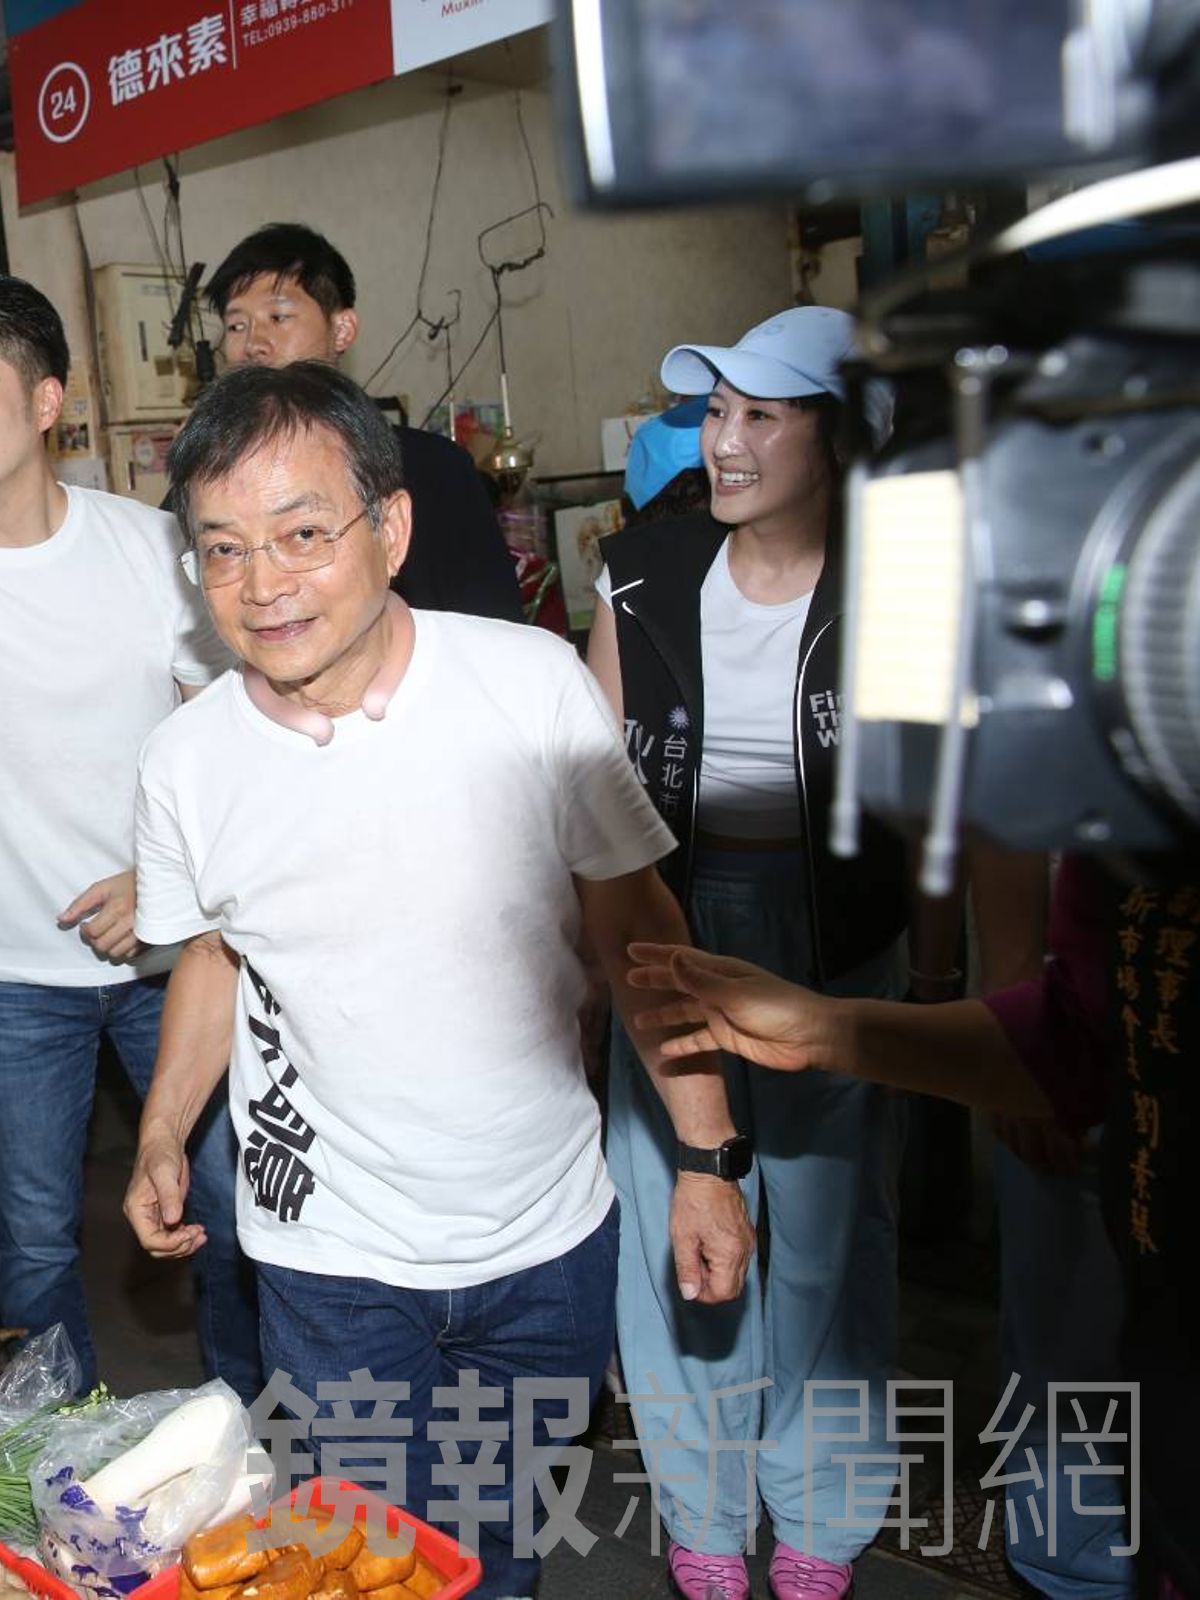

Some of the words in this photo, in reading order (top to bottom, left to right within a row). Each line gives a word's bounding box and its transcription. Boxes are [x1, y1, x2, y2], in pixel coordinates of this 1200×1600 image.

[105, 14, 229, 106] 德來素
[50, 83, 78, 121] 24
[809, 690, 841, 713] Fi
